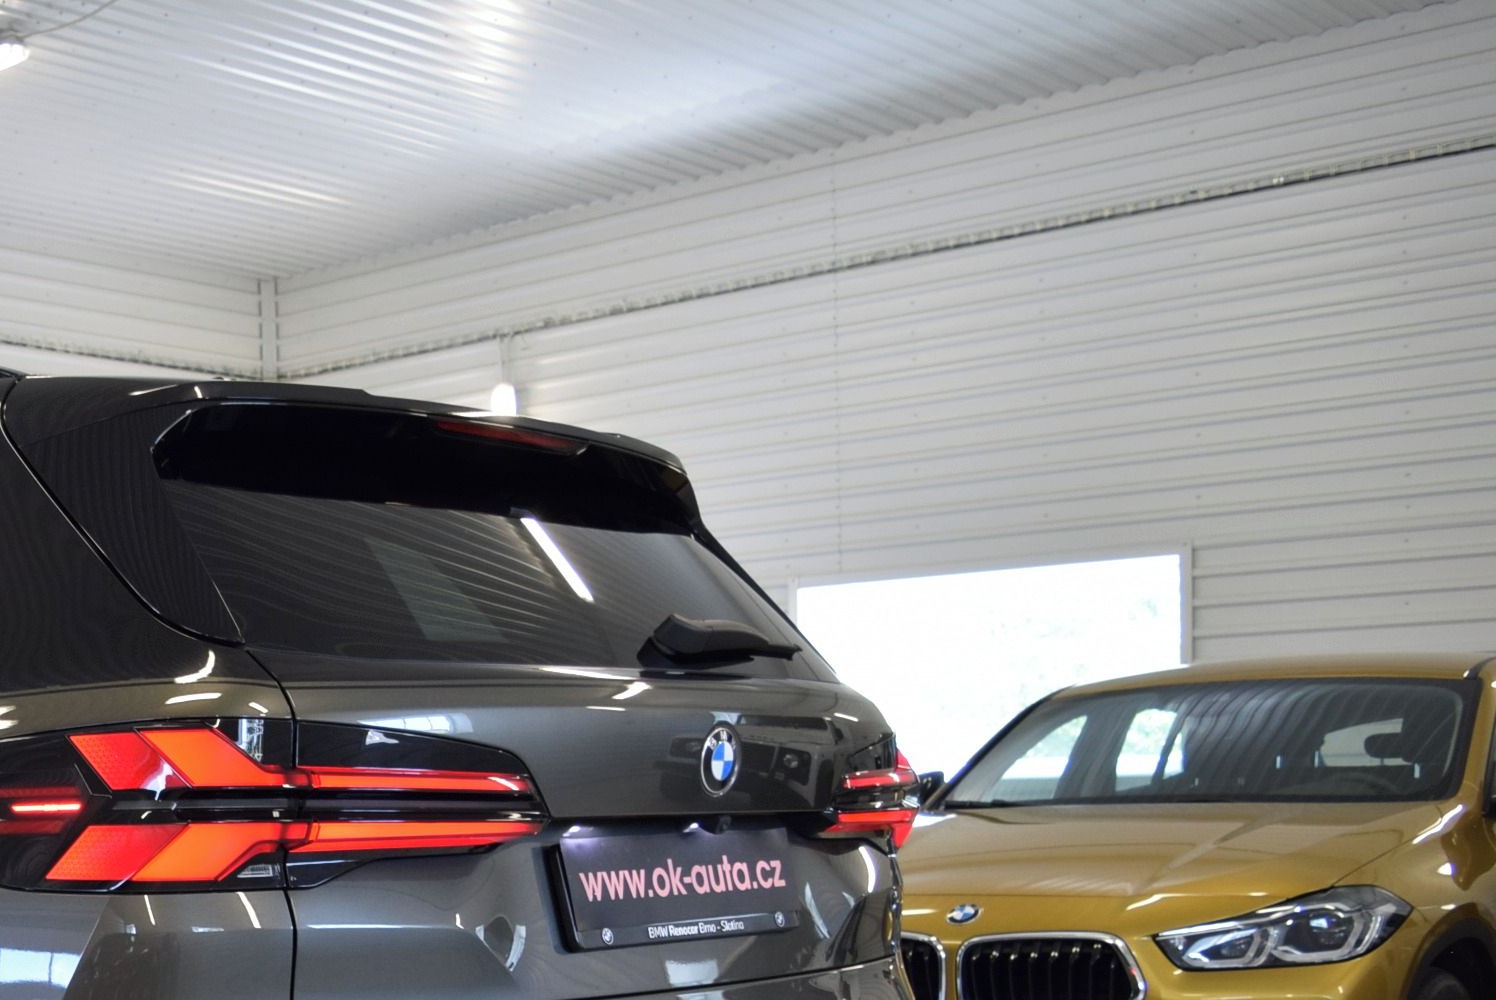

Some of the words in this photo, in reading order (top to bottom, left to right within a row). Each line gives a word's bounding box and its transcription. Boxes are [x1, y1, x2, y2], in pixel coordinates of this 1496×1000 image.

[579, 855, 786, 902] www.ok-auta.cz
[648, 926, 669, 939] BMW
[668, 925, 699, 936] Renocar
[698, 922, 716, 933] Brno
